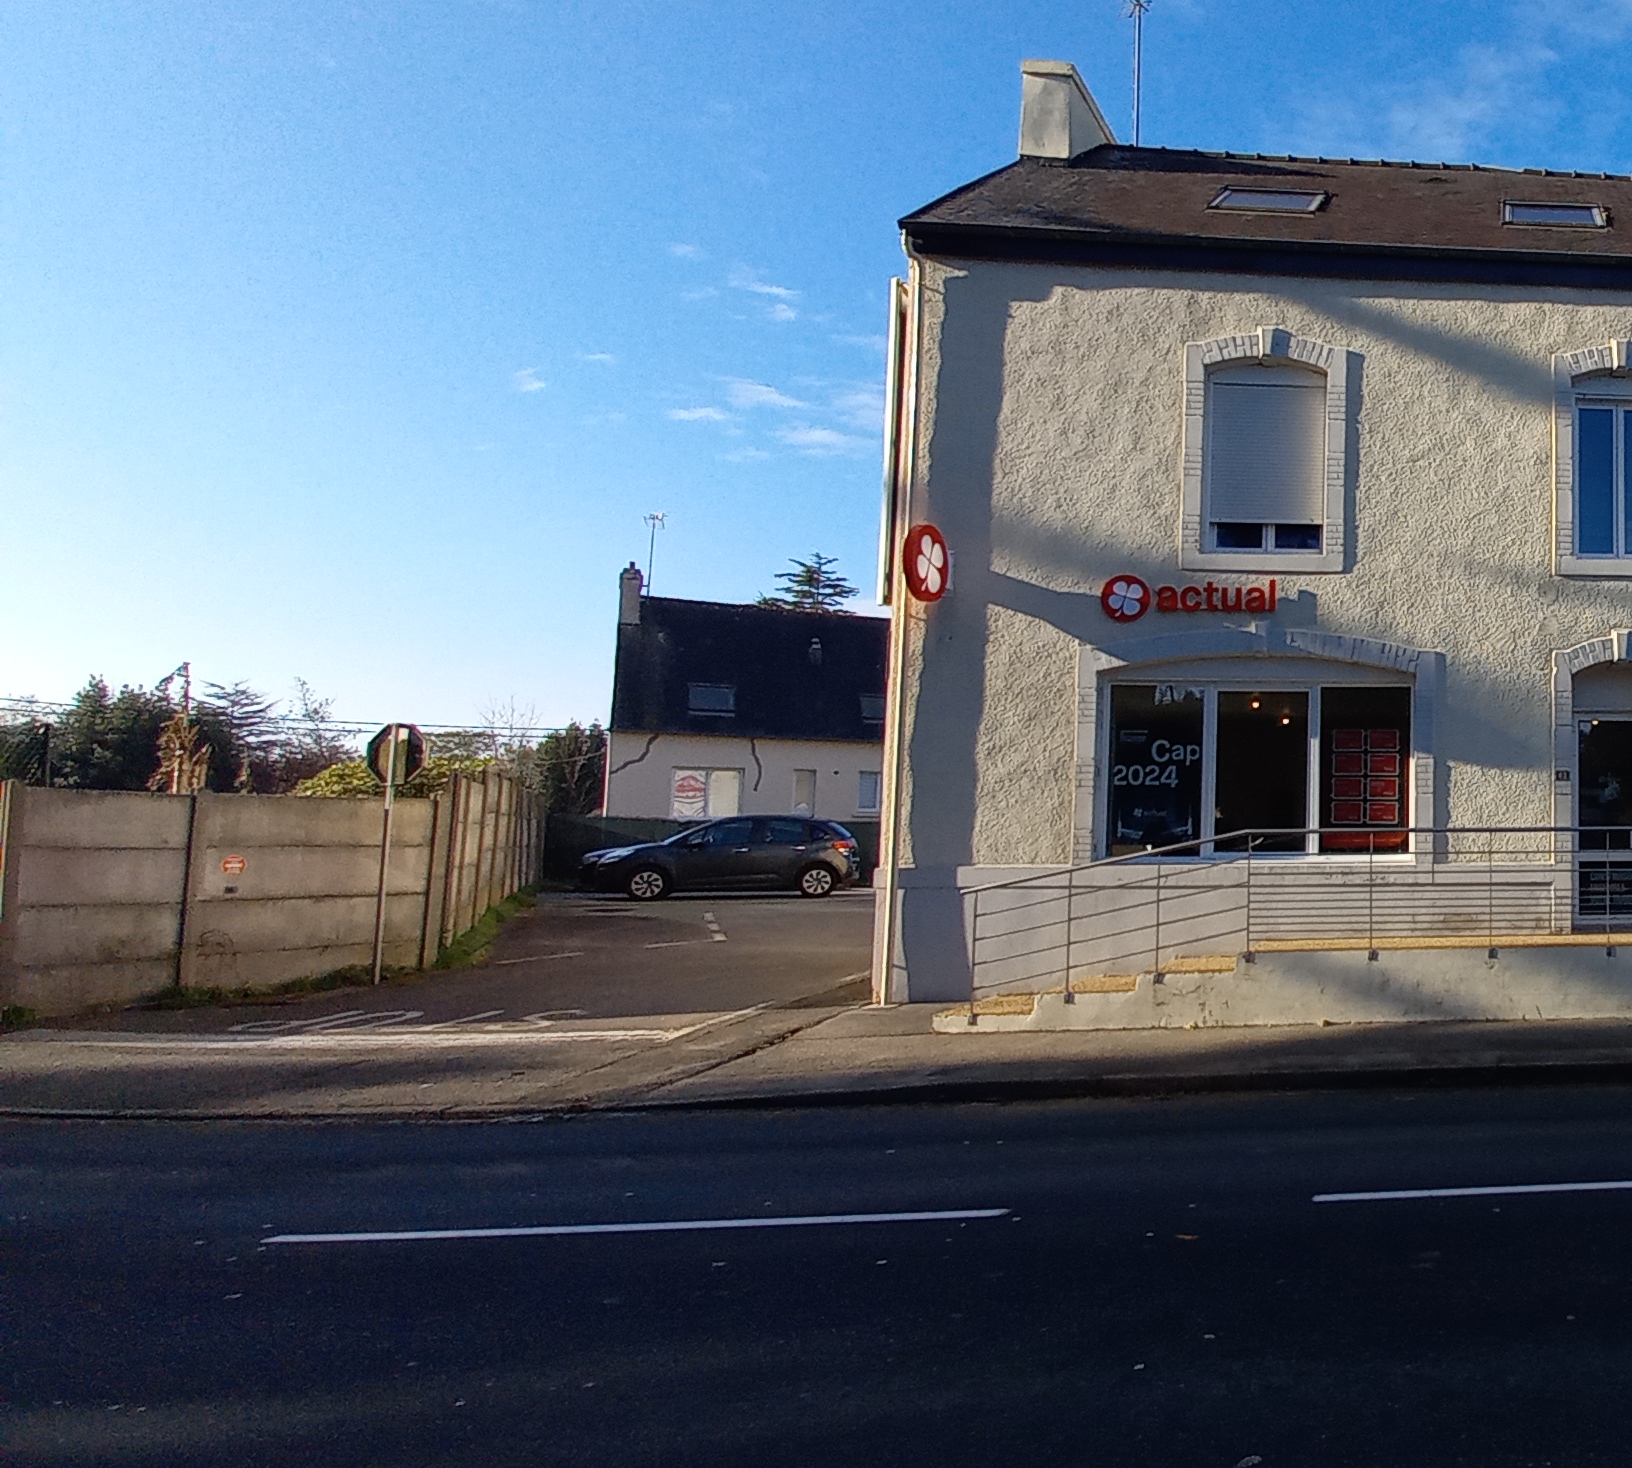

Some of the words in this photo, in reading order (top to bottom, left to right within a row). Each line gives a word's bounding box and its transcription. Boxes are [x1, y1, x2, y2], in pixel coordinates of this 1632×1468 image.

[1156, 579, 1277, 612] actual
[1151, 738, 1200, 766] Cap
[1113, 764, 1179, 788] 2024
